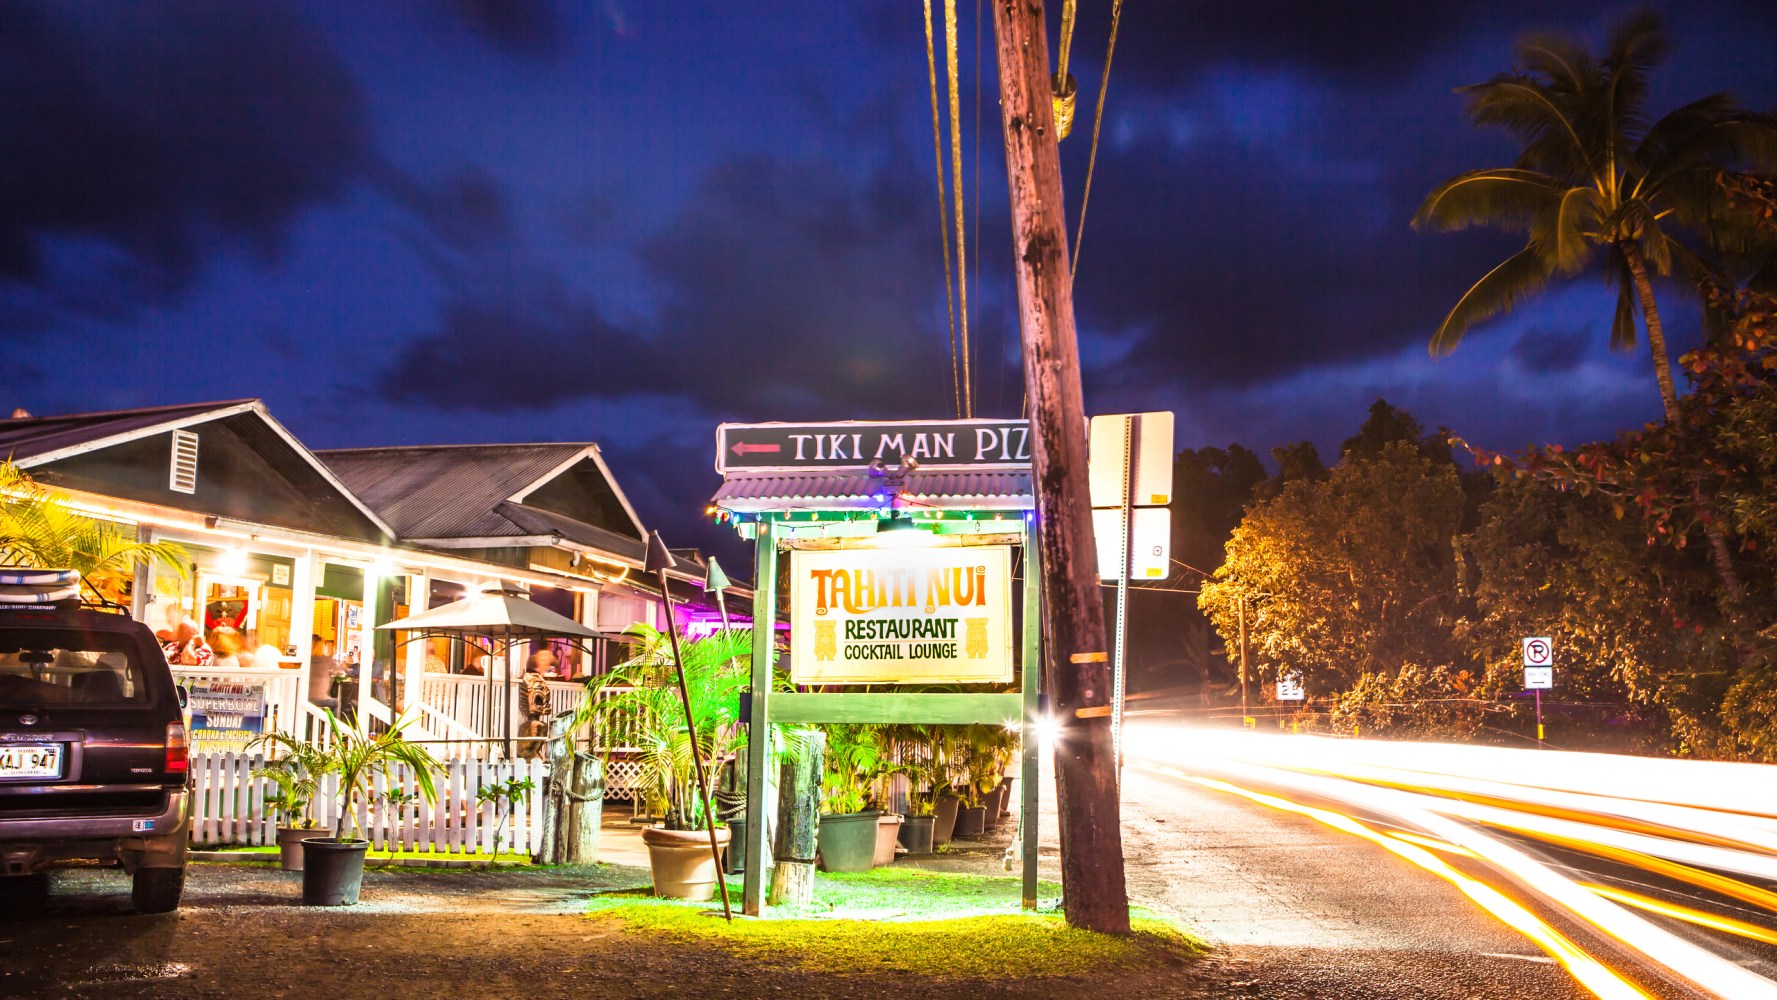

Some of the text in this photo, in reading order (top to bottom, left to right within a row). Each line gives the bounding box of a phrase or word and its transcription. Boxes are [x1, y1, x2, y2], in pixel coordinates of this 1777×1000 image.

[787, 434, 864, 460] TIKI
[874, 433, 955, 459] MAN
[845, 618, 958, 640] RESTAURANT
[844, 643, 957, 660] COCKTAIL LOUNGE
[209, 683, 231, 694] TAHITI
[231, 684, 244, 695] NUI
[206, 711, 244, 729] SUNDAY
[193, 729, 220, 740] CORONA
[225, 730, 253, 741] PACIFICO
[31, 753, 57, 769] 947
